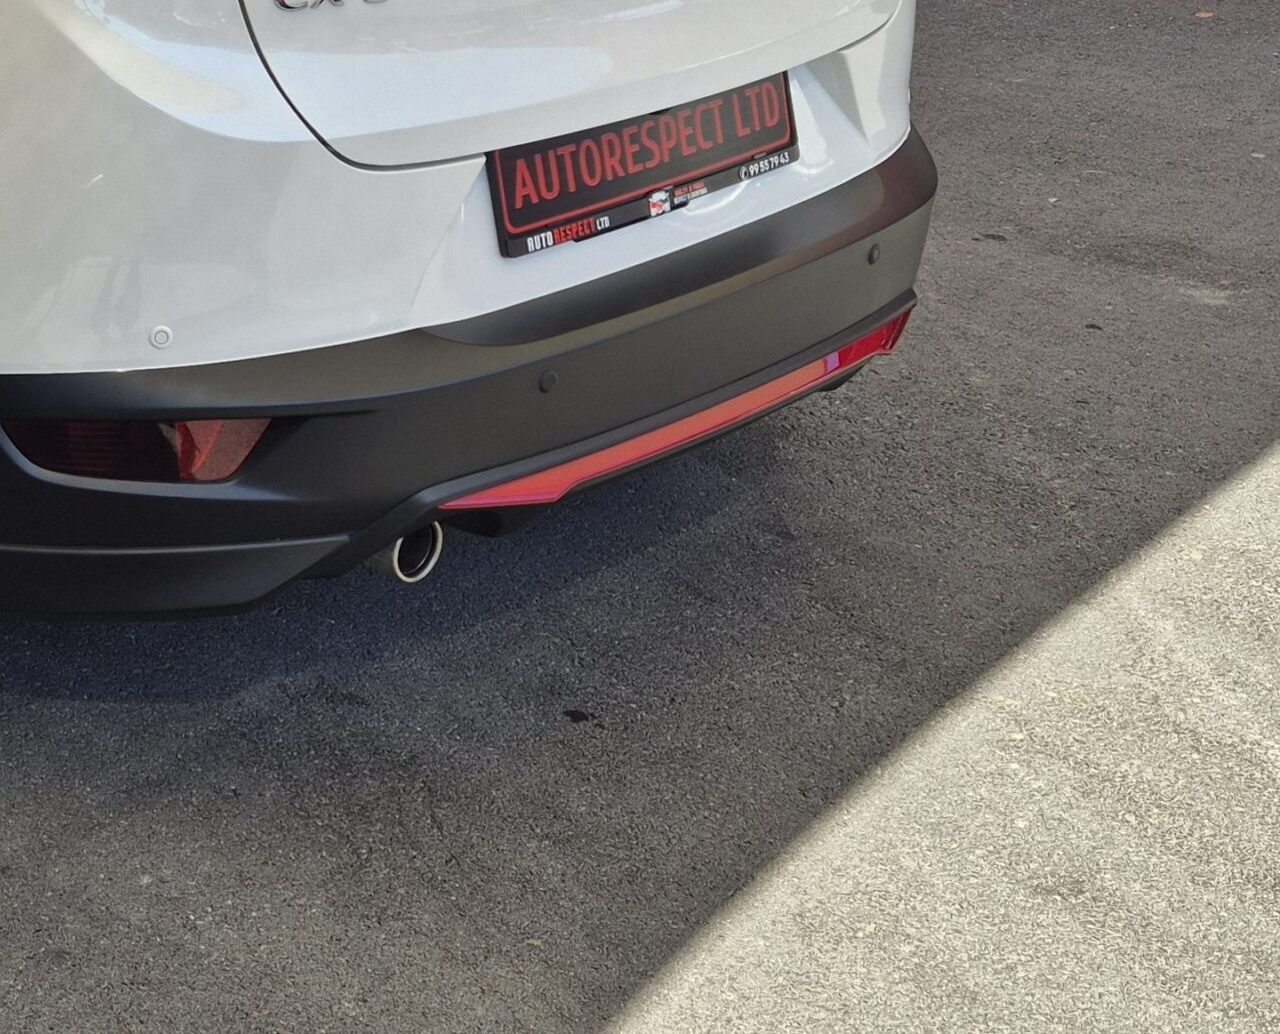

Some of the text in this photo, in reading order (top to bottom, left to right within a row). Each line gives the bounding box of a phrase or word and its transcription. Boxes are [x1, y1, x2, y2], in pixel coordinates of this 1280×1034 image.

[514, 81, 781, 210] AUTORESPECT LTD
[596, 215, 611, 231] LTD
